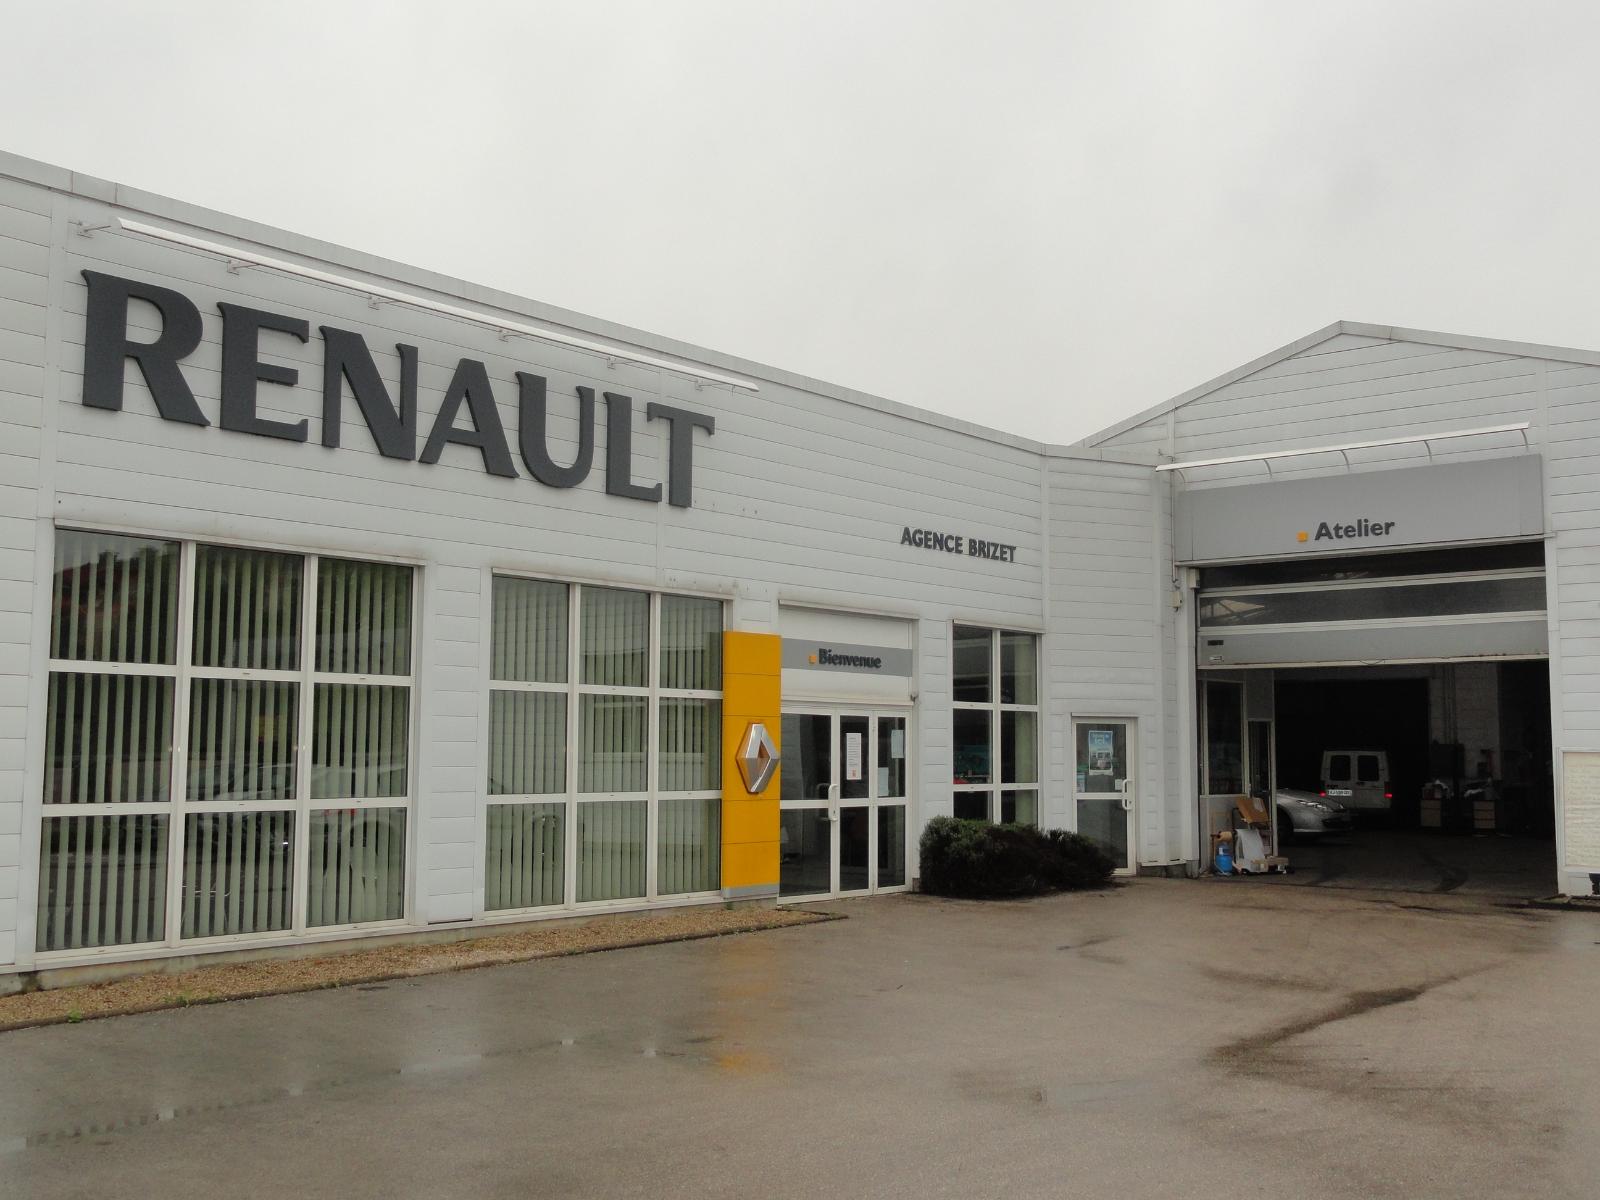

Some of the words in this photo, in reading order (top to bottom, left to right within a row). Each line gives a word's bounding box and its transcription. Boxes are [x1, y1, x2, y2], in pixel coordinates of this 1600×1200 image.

[80, 269, 716, 508] RENAULT
[1314, 519, 1395, 541] Atelier
[901, 527, 964, 554] AGENCE
[968, 538, 1017, 563] BRIZET
[818, 648, 882, 669] Bienvenue
